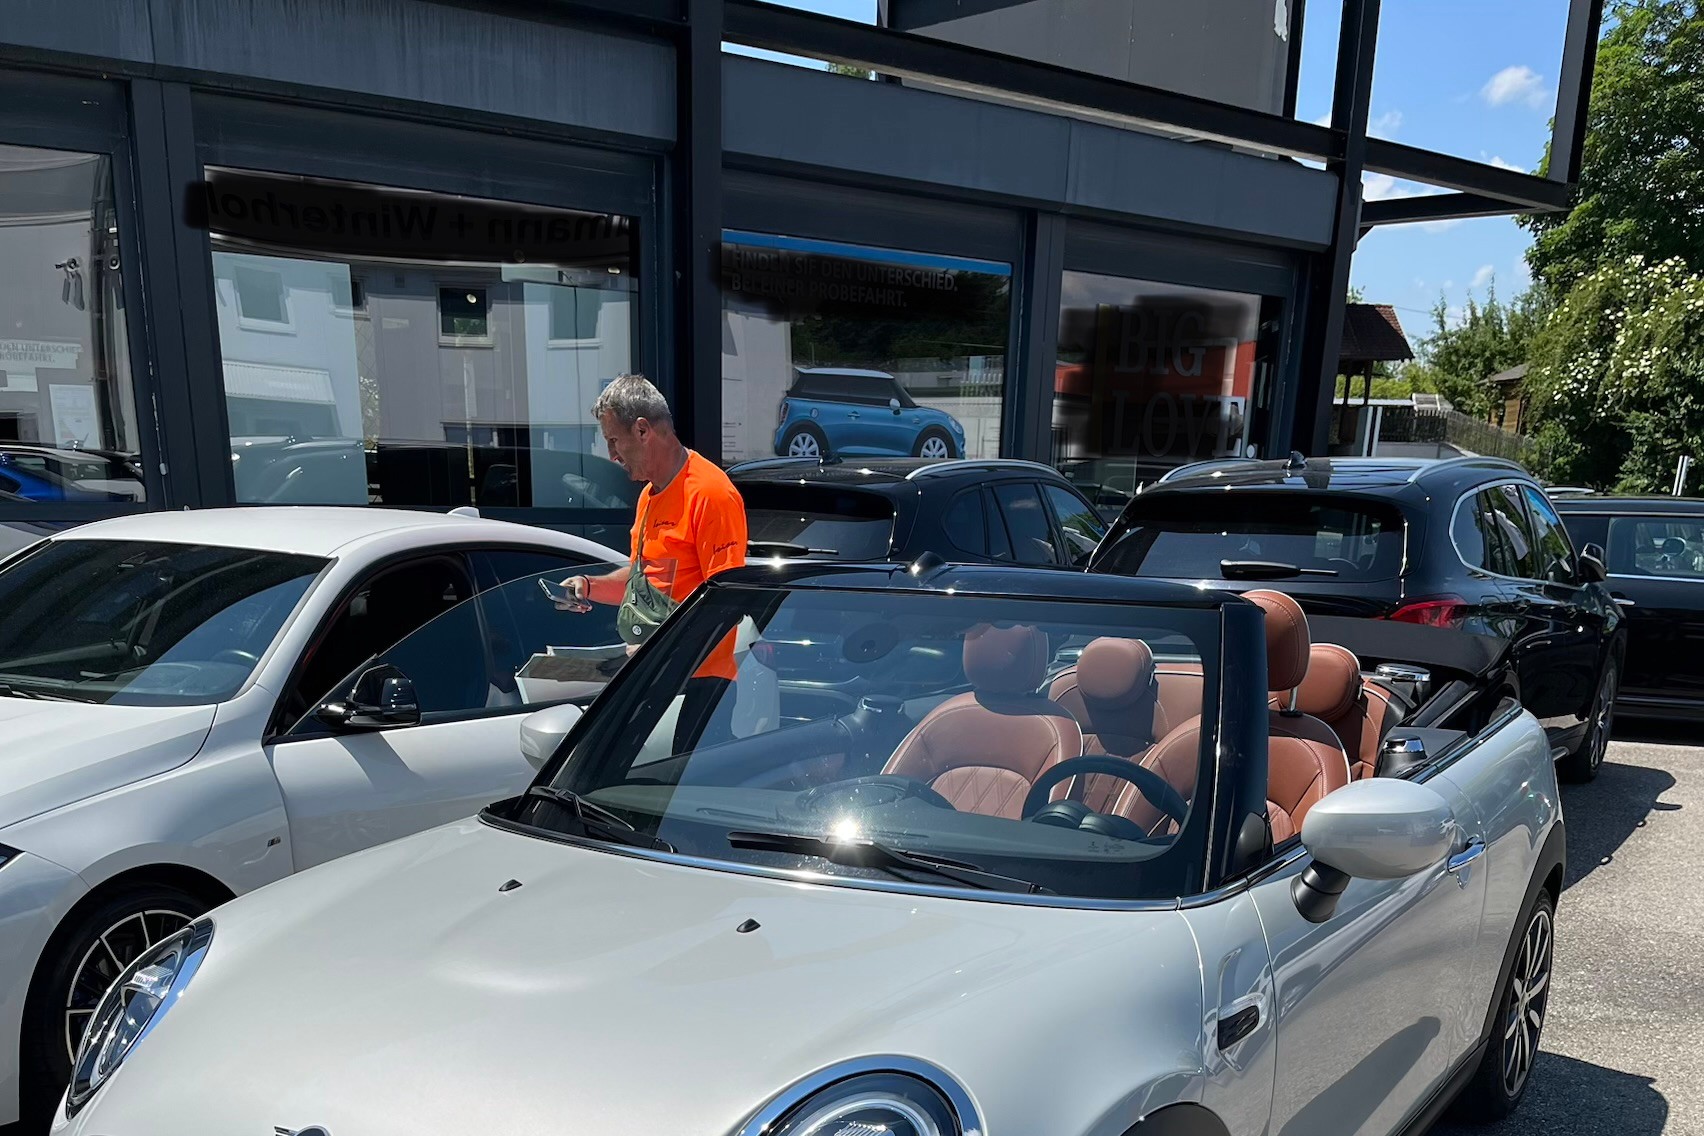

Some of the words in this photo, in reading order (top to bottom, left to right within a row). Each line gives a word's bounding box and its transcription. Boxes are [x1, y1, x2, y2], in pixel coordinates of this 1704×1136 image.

[733, 249, 790, 272] FINDEN
[822, 260, 852, 279] DEN
[857, 263, 958, 292] UNTERSCHIED.
[810, 280, 907, 307] PROBEFAHRT.
[1114, 307, 1207, 377] BIG
[1108, 389, 1246, 458] LOVE
